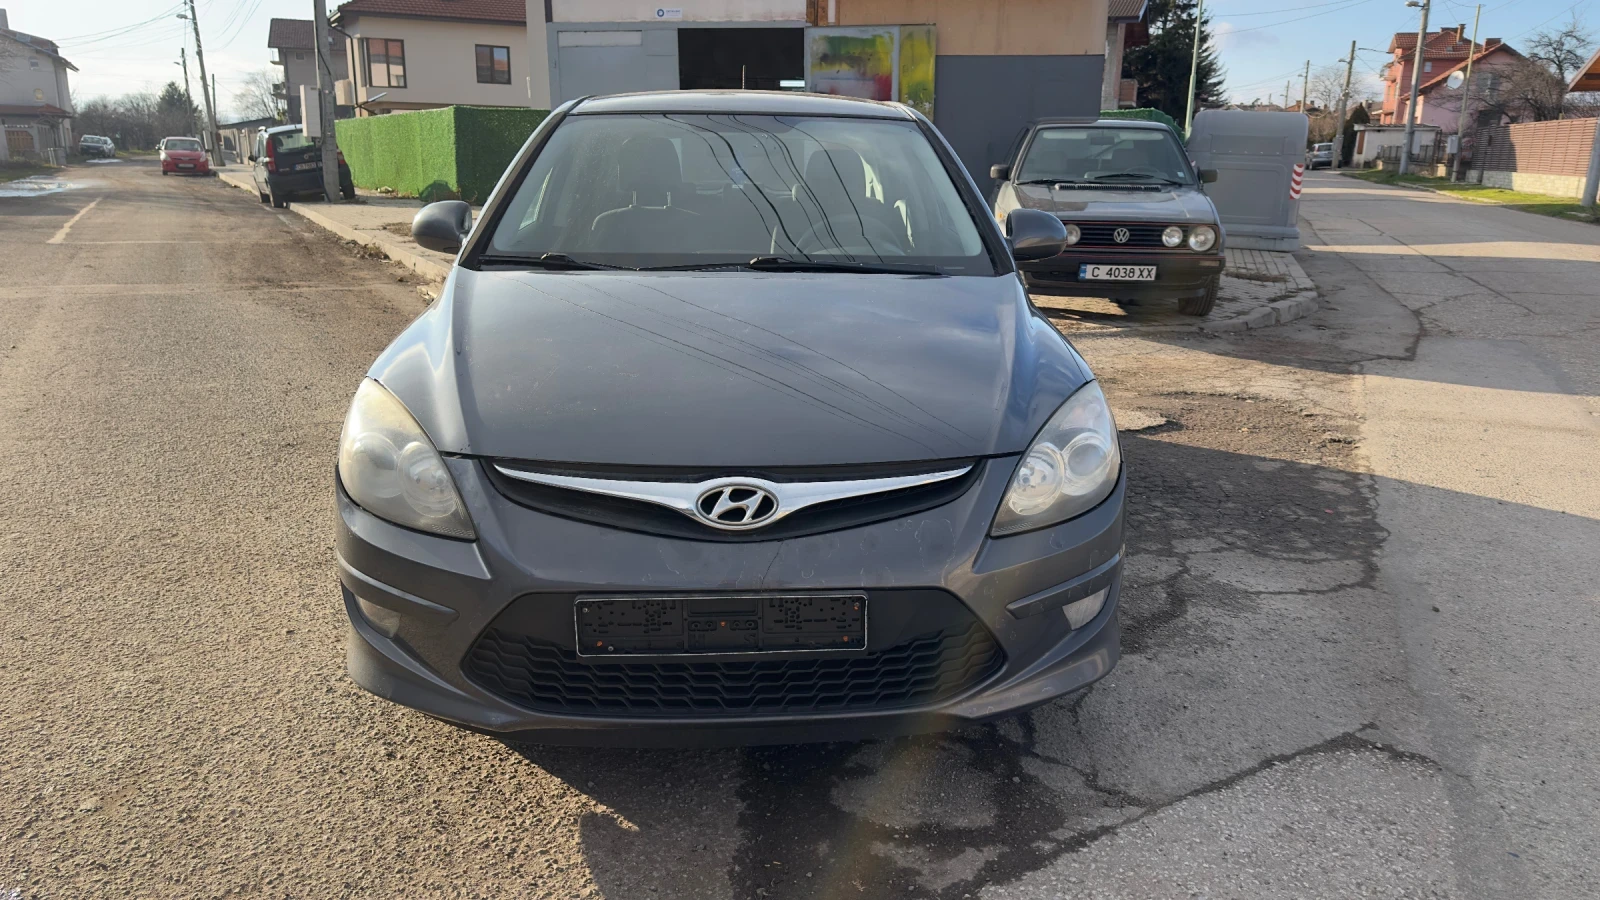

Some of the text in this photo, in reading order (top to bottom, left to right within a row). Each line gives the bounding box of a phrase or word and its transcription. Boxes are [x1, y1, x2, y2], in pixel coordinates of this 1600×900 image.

[1091, 266, 1100, 278] C
[1105, 267, 1135, 279] 4038
[1137, 267, 1154, 279] XX
